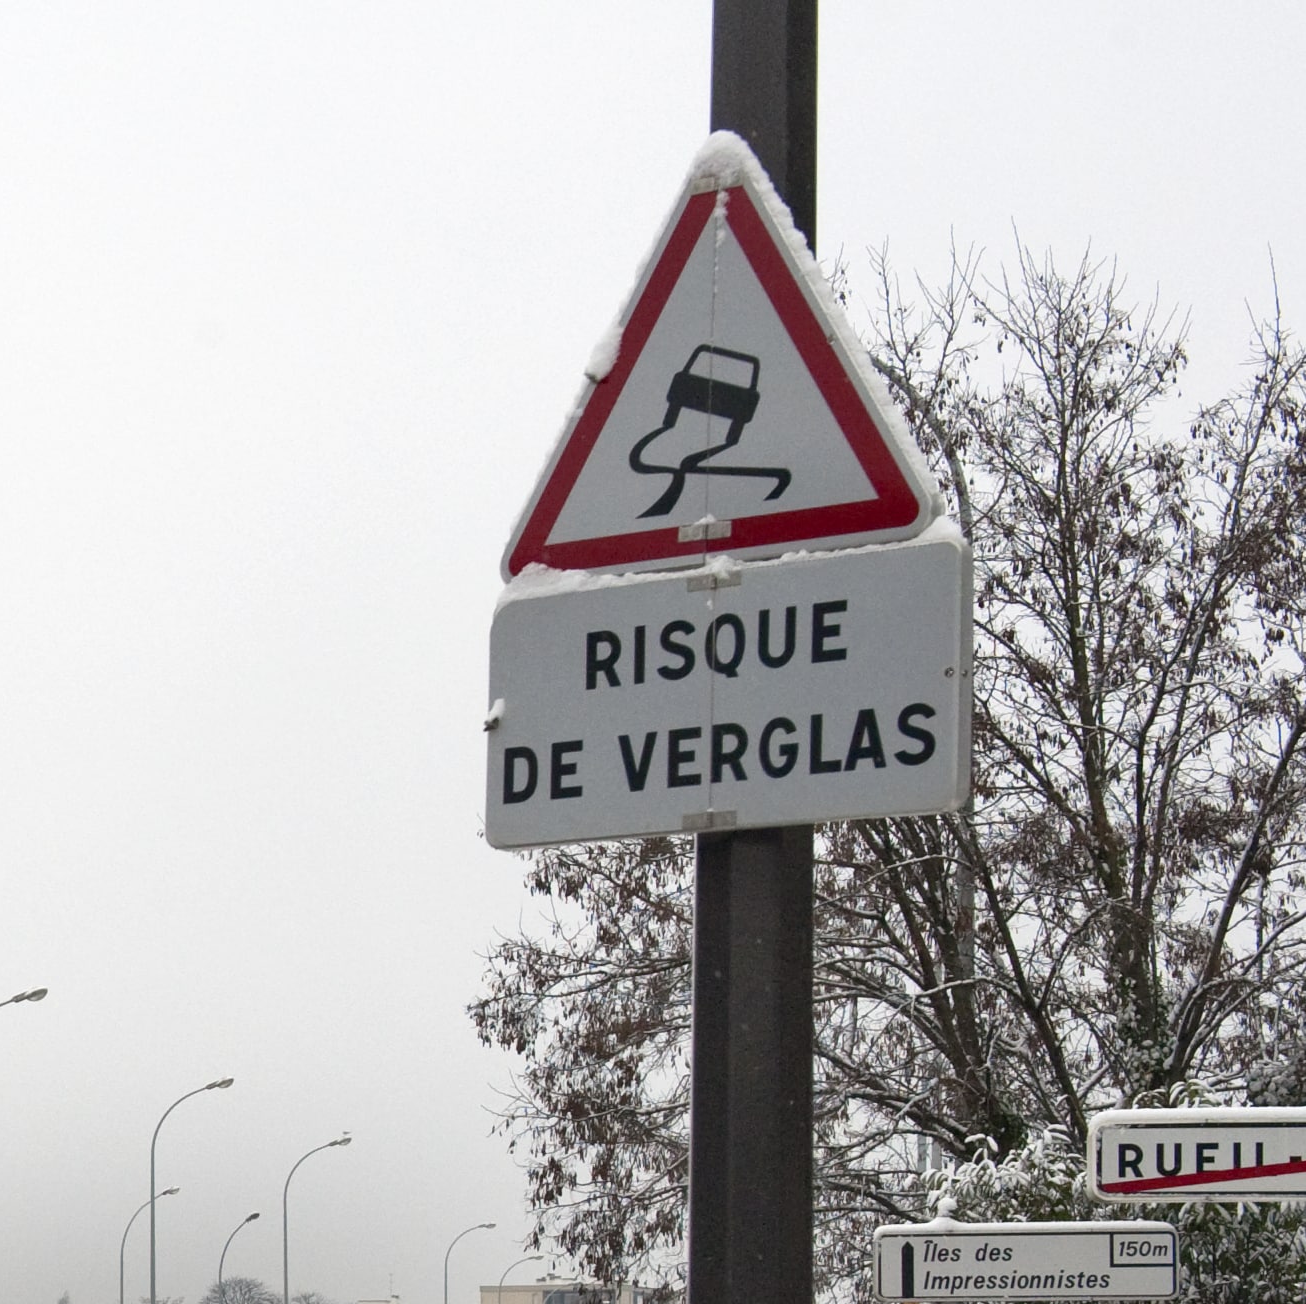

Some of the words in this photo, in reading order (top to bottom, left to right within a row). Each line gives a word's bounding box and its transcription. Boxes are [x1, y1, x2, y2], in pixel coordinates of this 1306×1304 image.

[585, 599, 848, 690] RISQUE
[503, 739, 584, 805] DE
[618, 702, 936, 792] VERGLAS
[923, 1240, 961, 1262] Îles
[975, 1243, 1013, 1262] des
[1118, 1241, 1168, 1257] 150m
[923, 1269, 1111, 1294] Impressionnistes
